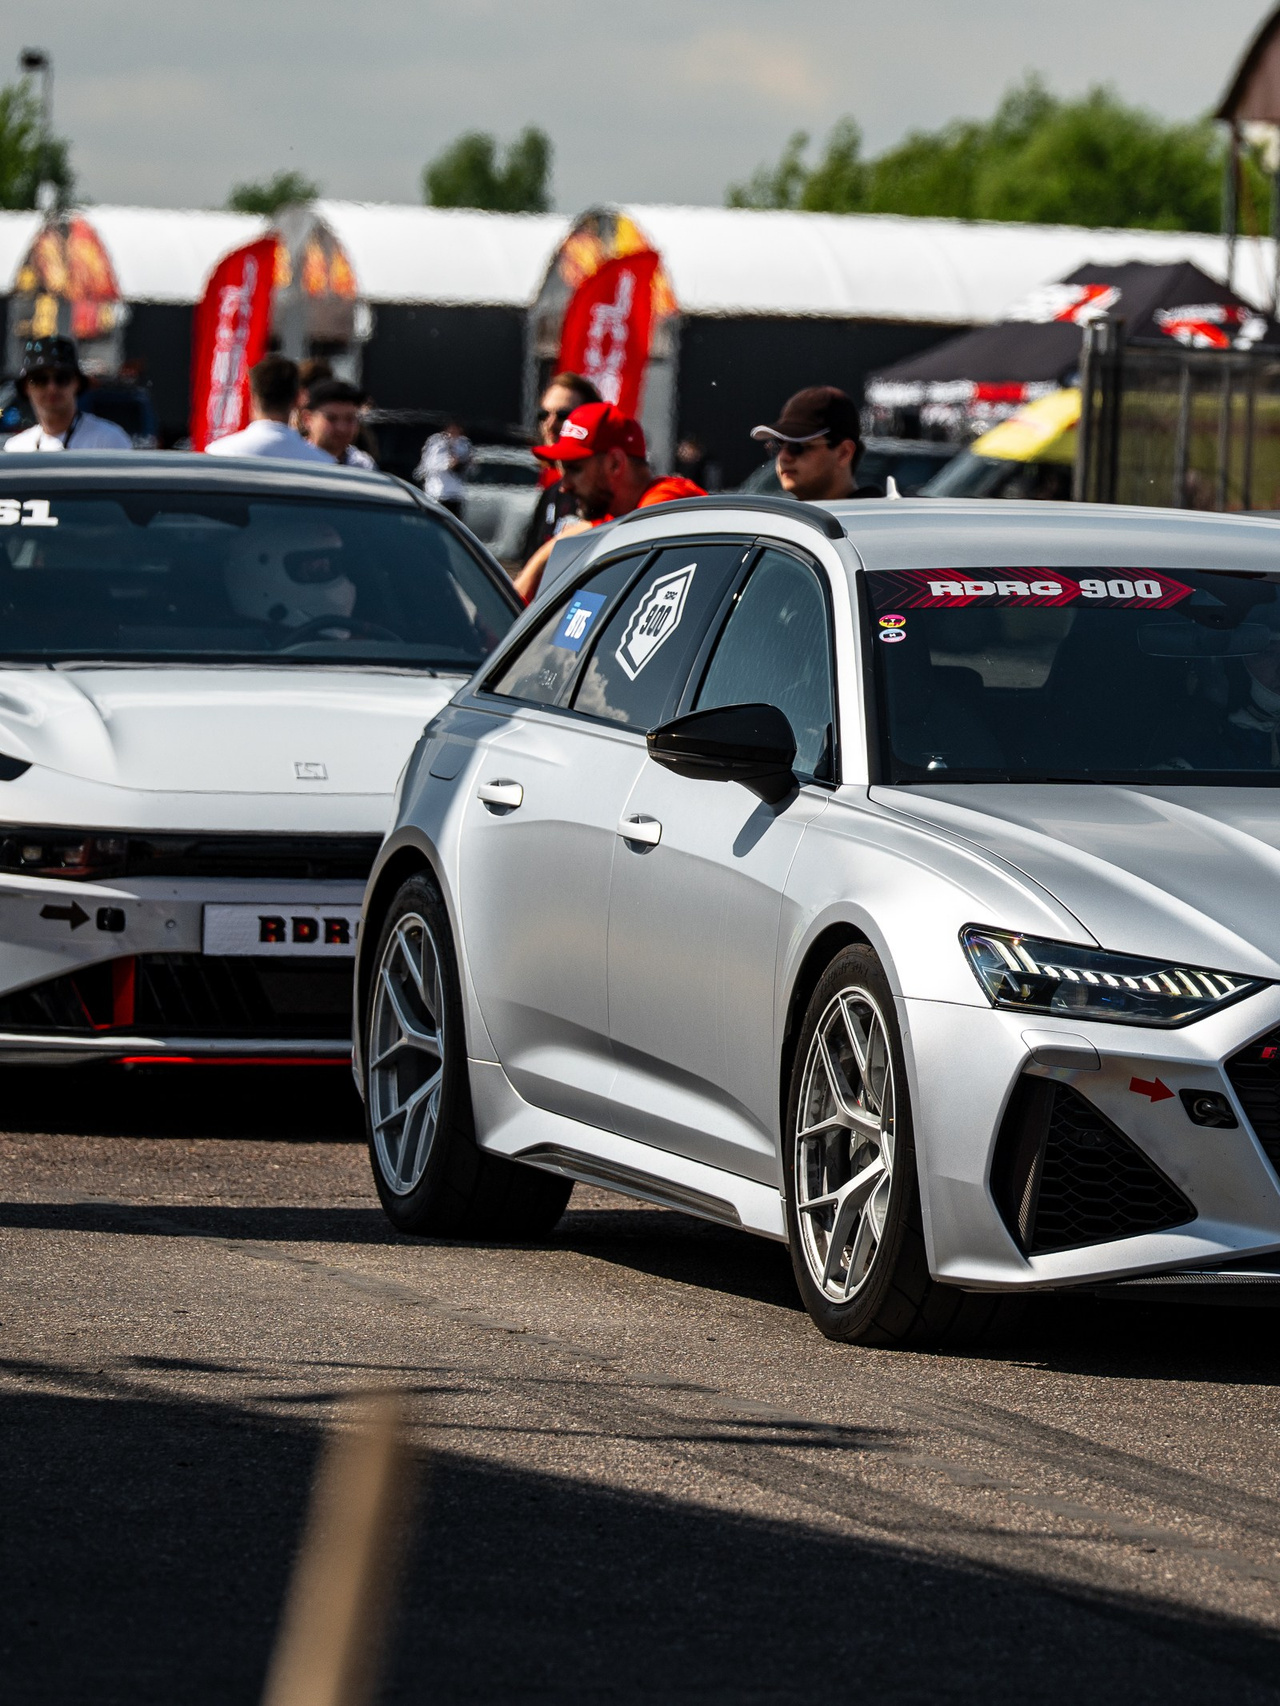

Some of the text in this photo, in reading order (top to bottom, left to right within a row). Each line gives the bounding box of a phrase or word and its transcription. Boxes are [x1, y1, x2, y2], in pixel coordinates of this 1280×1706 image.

[927, 579, 1164, 599] RDRC 900
[639, 604, 673, 637] 900
[257, 905, 359, 944] RDR
